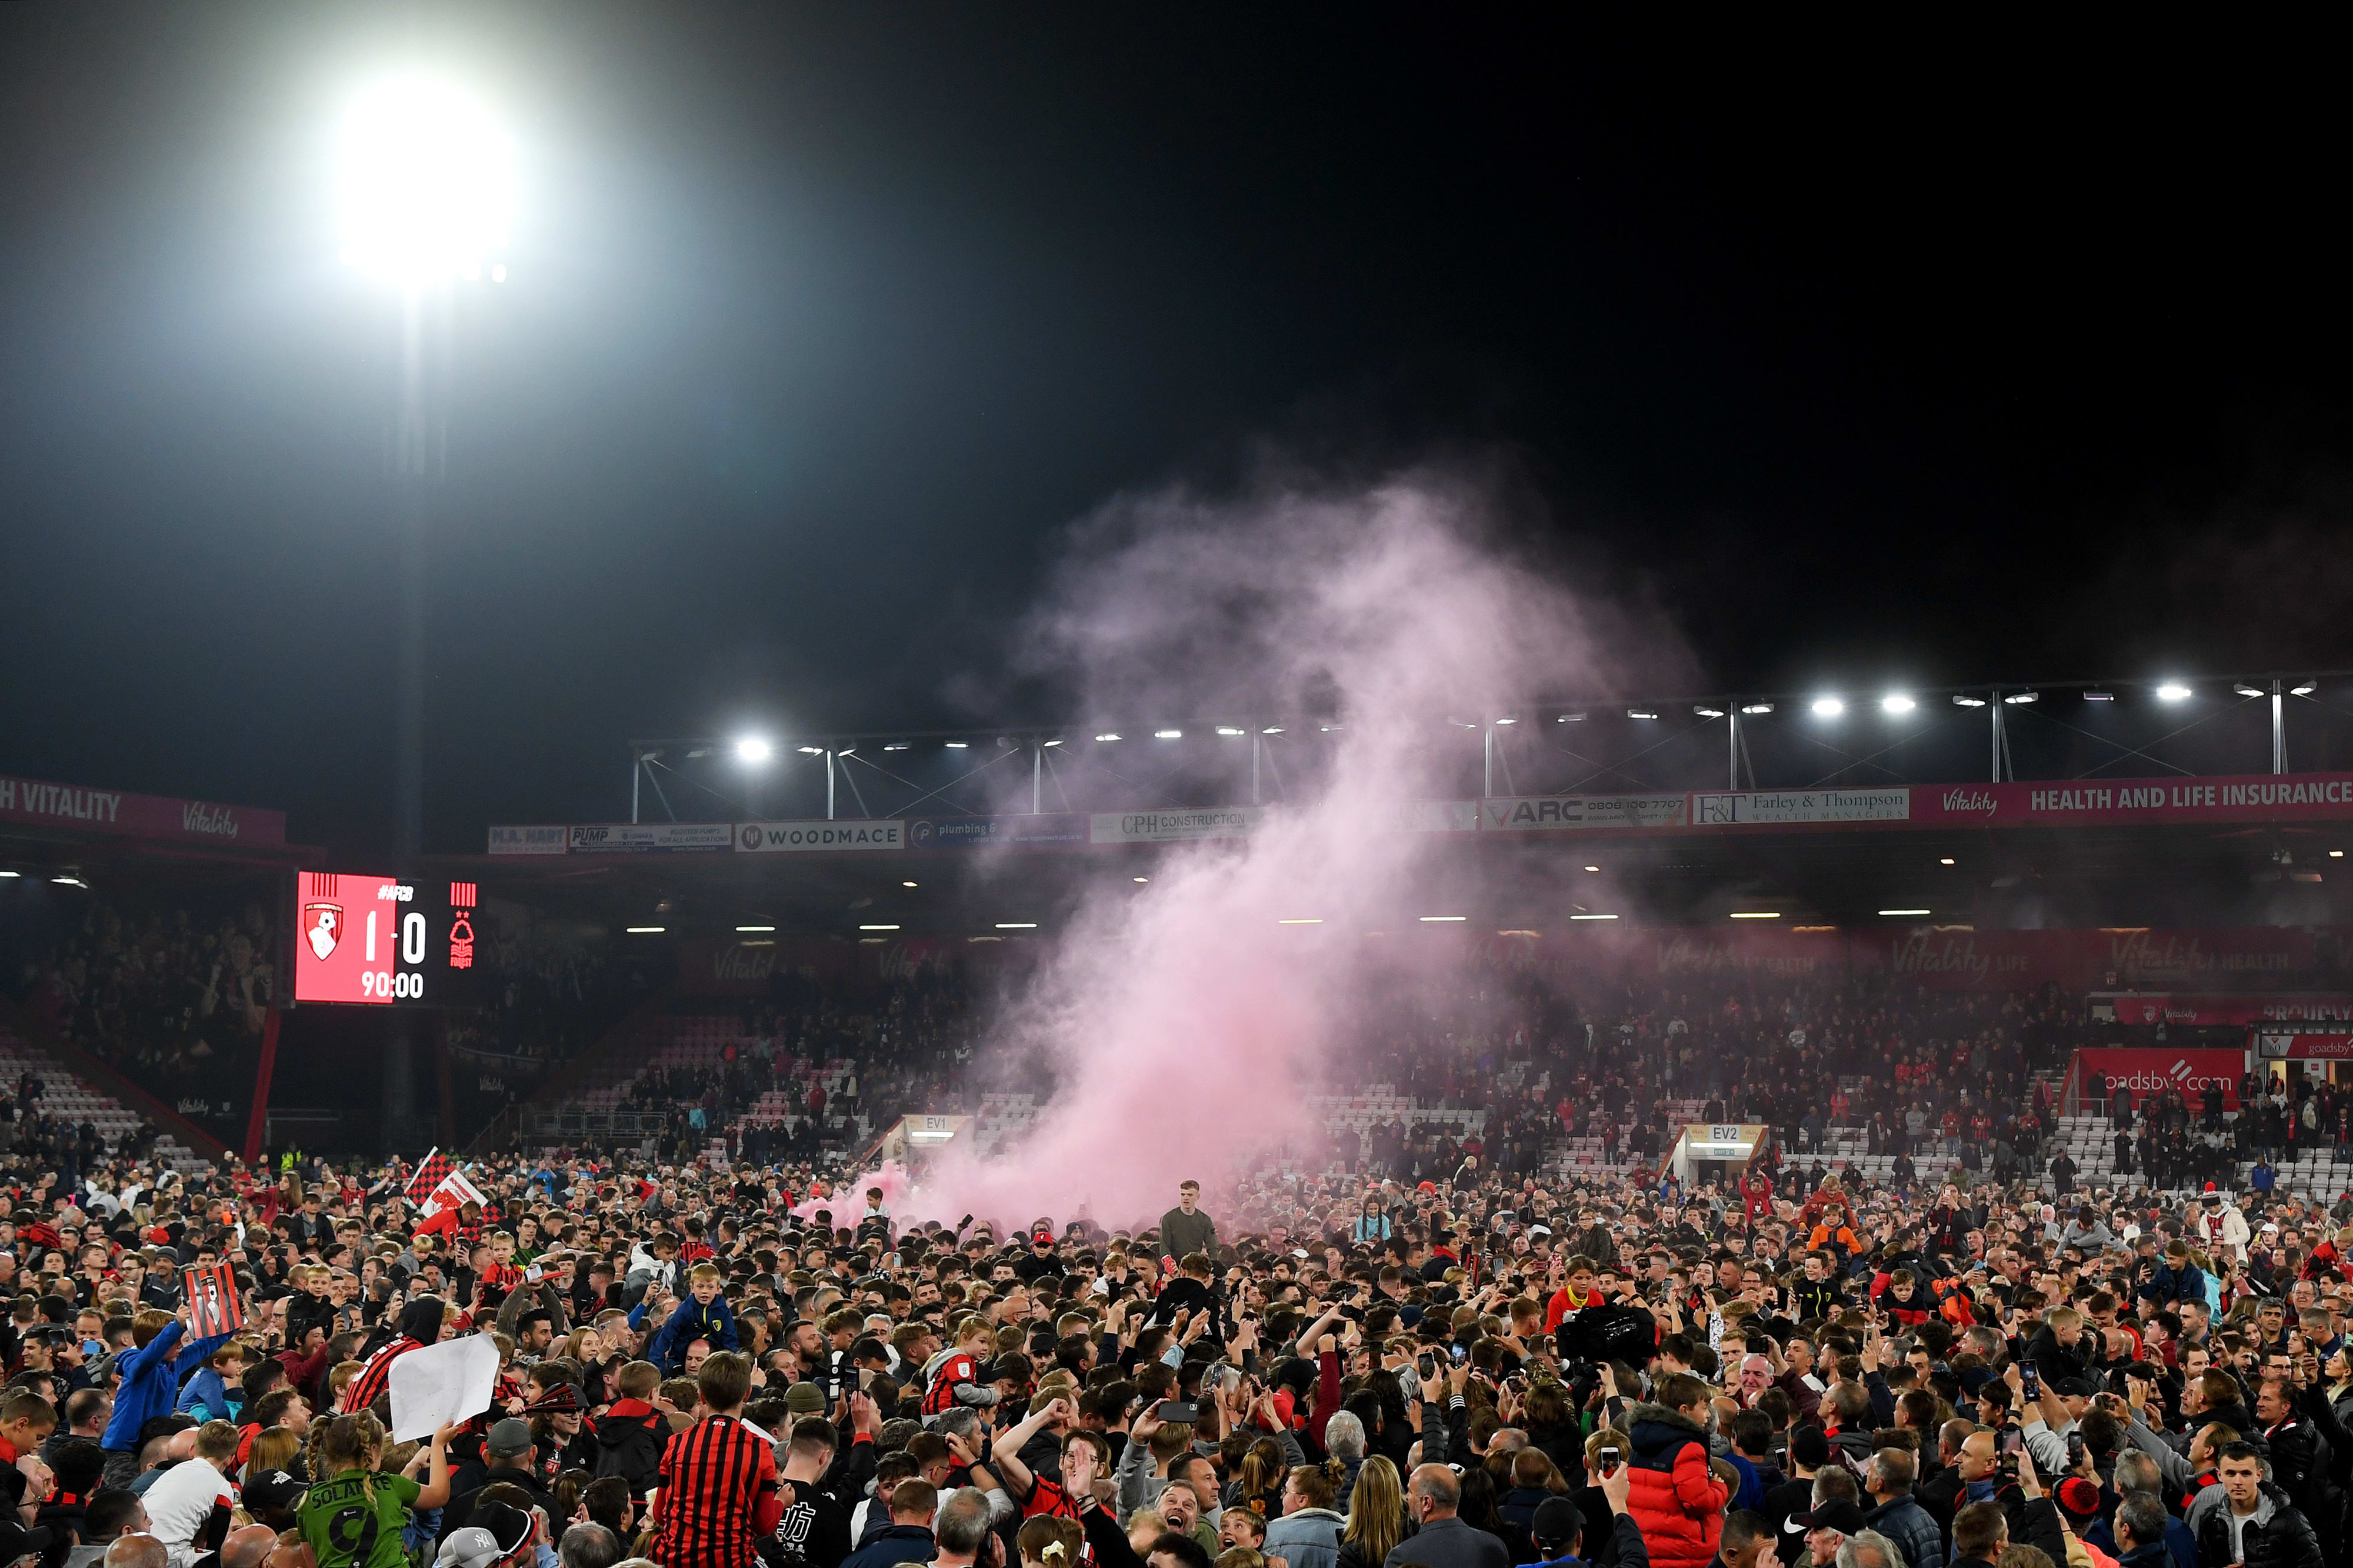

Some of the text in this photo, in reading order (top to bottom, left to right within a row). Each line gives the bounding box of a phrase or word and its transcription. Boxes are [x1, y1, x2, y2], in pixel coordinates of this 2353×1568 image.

[22, 783, 121, 822] VITALITY
[1651, 800, 1684, 809] 7707
[1753, 793, 1903, 812] Farley & Thompson
[1943, 788, 1997, 817] Vitality
[2031, 782, 2353, 810] HEALTH AND LIFE INSURANCE
[183, 801, 238, 839] Vitality
[1512, 800, 1582, 822] ARC
[1752, 810, 1904, 821] WEALTH MANAGERS
[939, 823, 986, 836] plumbing
[1122, 814, 1245, 833] CPH CONSTRUCTION
[573, 828, 610, 842] PUMP
[768, 828, 898, 845] WOODMACE
[378, 885, 414, 902] #AFCB
[366, 911, 376, 961] 1
[403, 912, 426, 964] 0
[1892, 935, 2029, 983] Vitality LIFE
[2221, 953, 2289, 970] HEALTH
[362, 971, 424, 999] 90:00
[2165, 1007, 2197, 1020] Vitality
[2309, 1042, 2349, 1055] goadsby
[927, 1118, 945, 1129] EV1
[1714, 1127, 1737, 1139] EV2
[329, 1506, 378, 1568] 9
